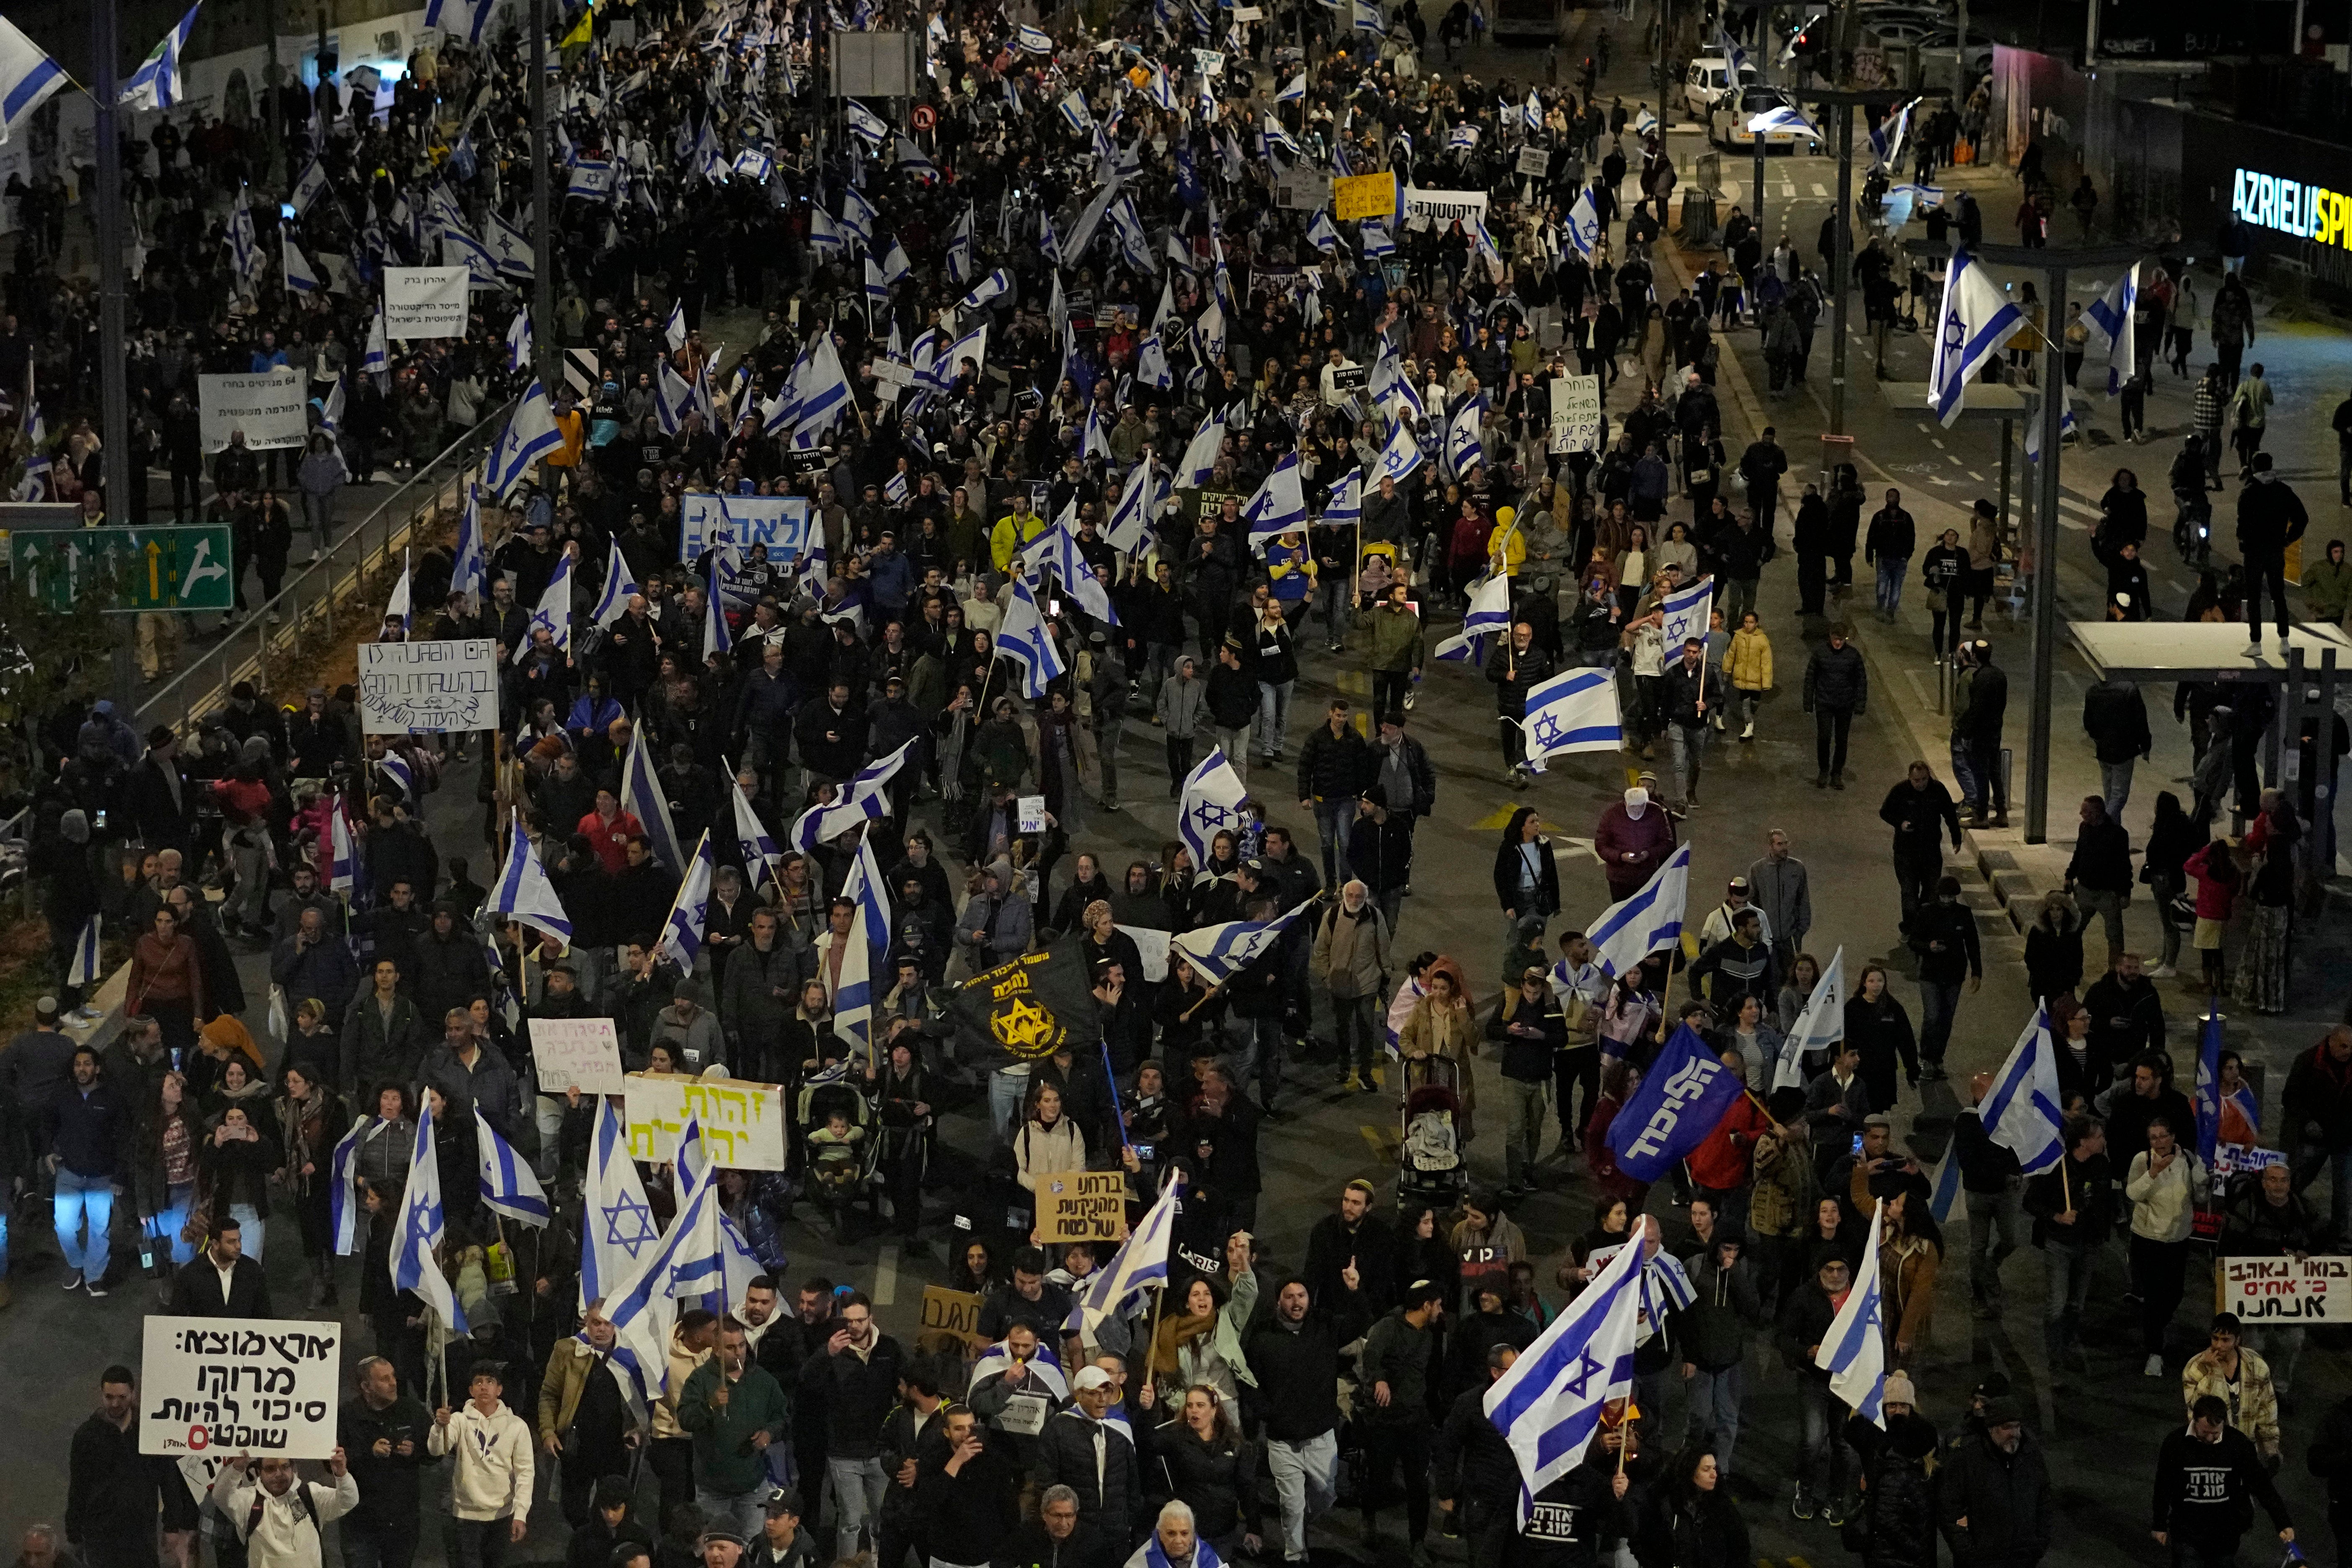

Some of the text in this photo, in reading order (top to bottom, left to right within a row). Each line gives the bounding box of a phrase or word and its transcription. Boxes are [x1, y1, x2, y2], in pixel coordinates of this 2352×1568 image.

[2315, 188, 2352, 251] SPI
[424, 276, 446, 285] אהרון
[389, 303, 436, 312] הדיקטטורה
[266, 404, 301, 414] רפורמה
[1556, 438, 1576, 451] קול
[465, 642, 490, 660] גם
[992, 969, 1029, 999] להבה
[680, 1085, 766, 1125] זהות
[1078, 1175, 1122, 1195] ברחנו
[1087, 1214, 1115, 1238] של
[2229, 1260, 2348, 1282] בואו נאהב
[2244, 1279, 2297, 1295] אחים
[2237, 1295, 2325, 1318] אנחנו
[175, 1330, 336, 1364] ארץ מוצא:
[197, 1365, 296, 1400] מרוקו
[151, 1394, 327, 1423] סיכוי להיות
[1018, 1405, 1040, 1414] אהרון
[208, 1427, 287, 1448] שופט:
[2190, 1472, 2226, 1485] אזרח
[2186, 1483, 2225, 1497] סוג ב'
[1534, 1506, 1573, 1522] אזרח
[1545, 1521, 1571, 1536] סוג
